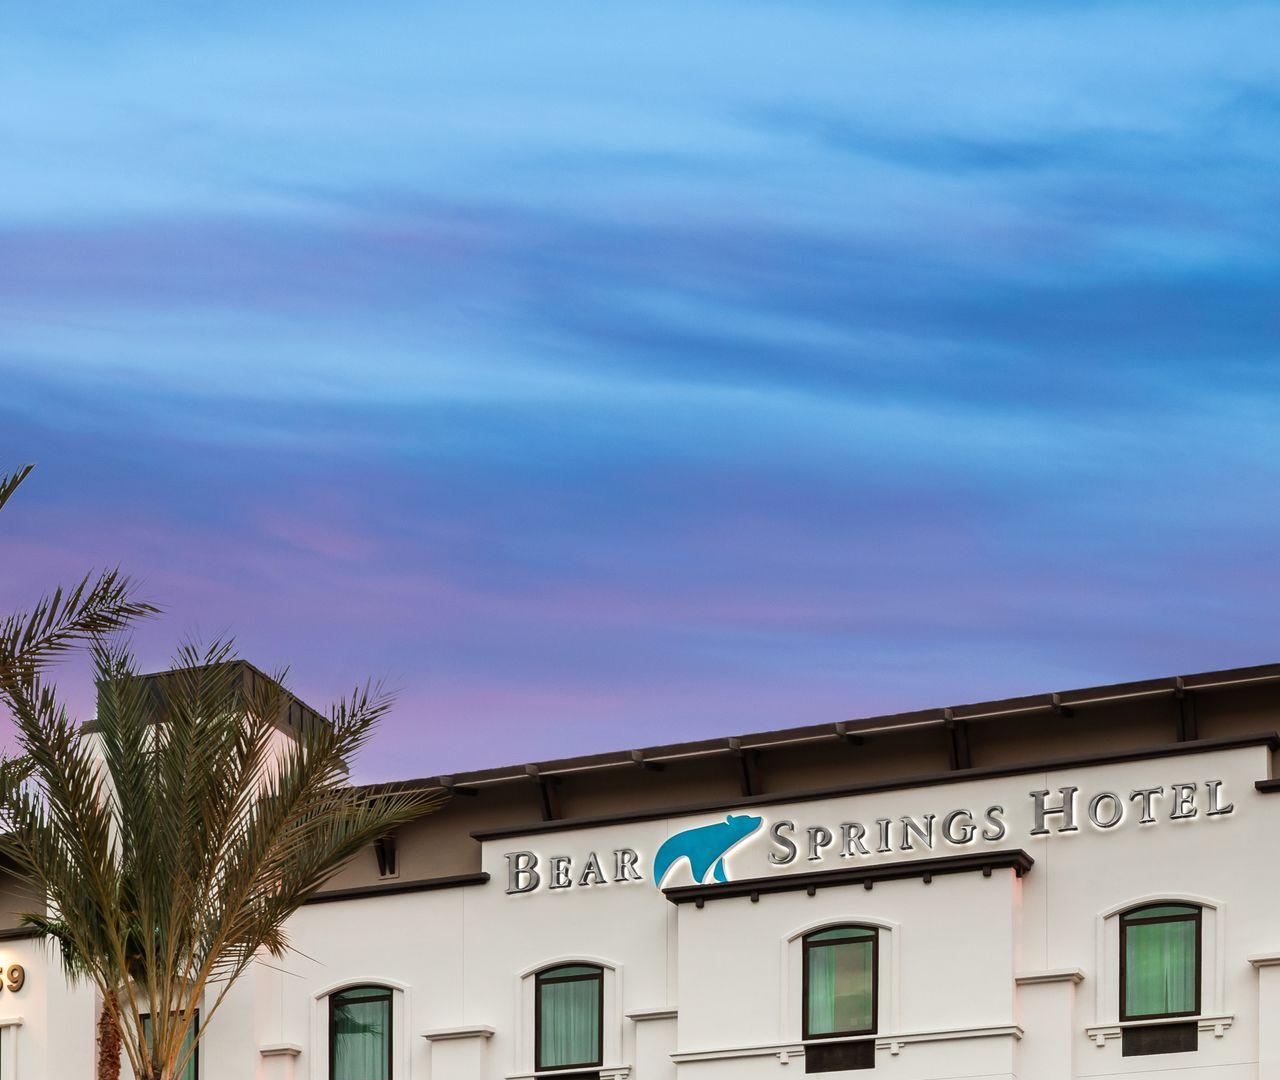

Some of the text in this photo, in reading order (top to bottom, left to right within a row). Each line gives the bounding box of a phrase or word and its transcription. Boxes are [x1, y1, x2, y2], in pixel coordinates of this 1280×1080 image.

[504, 779, 1235, 895] BEAR SPRINGS HOTEL
